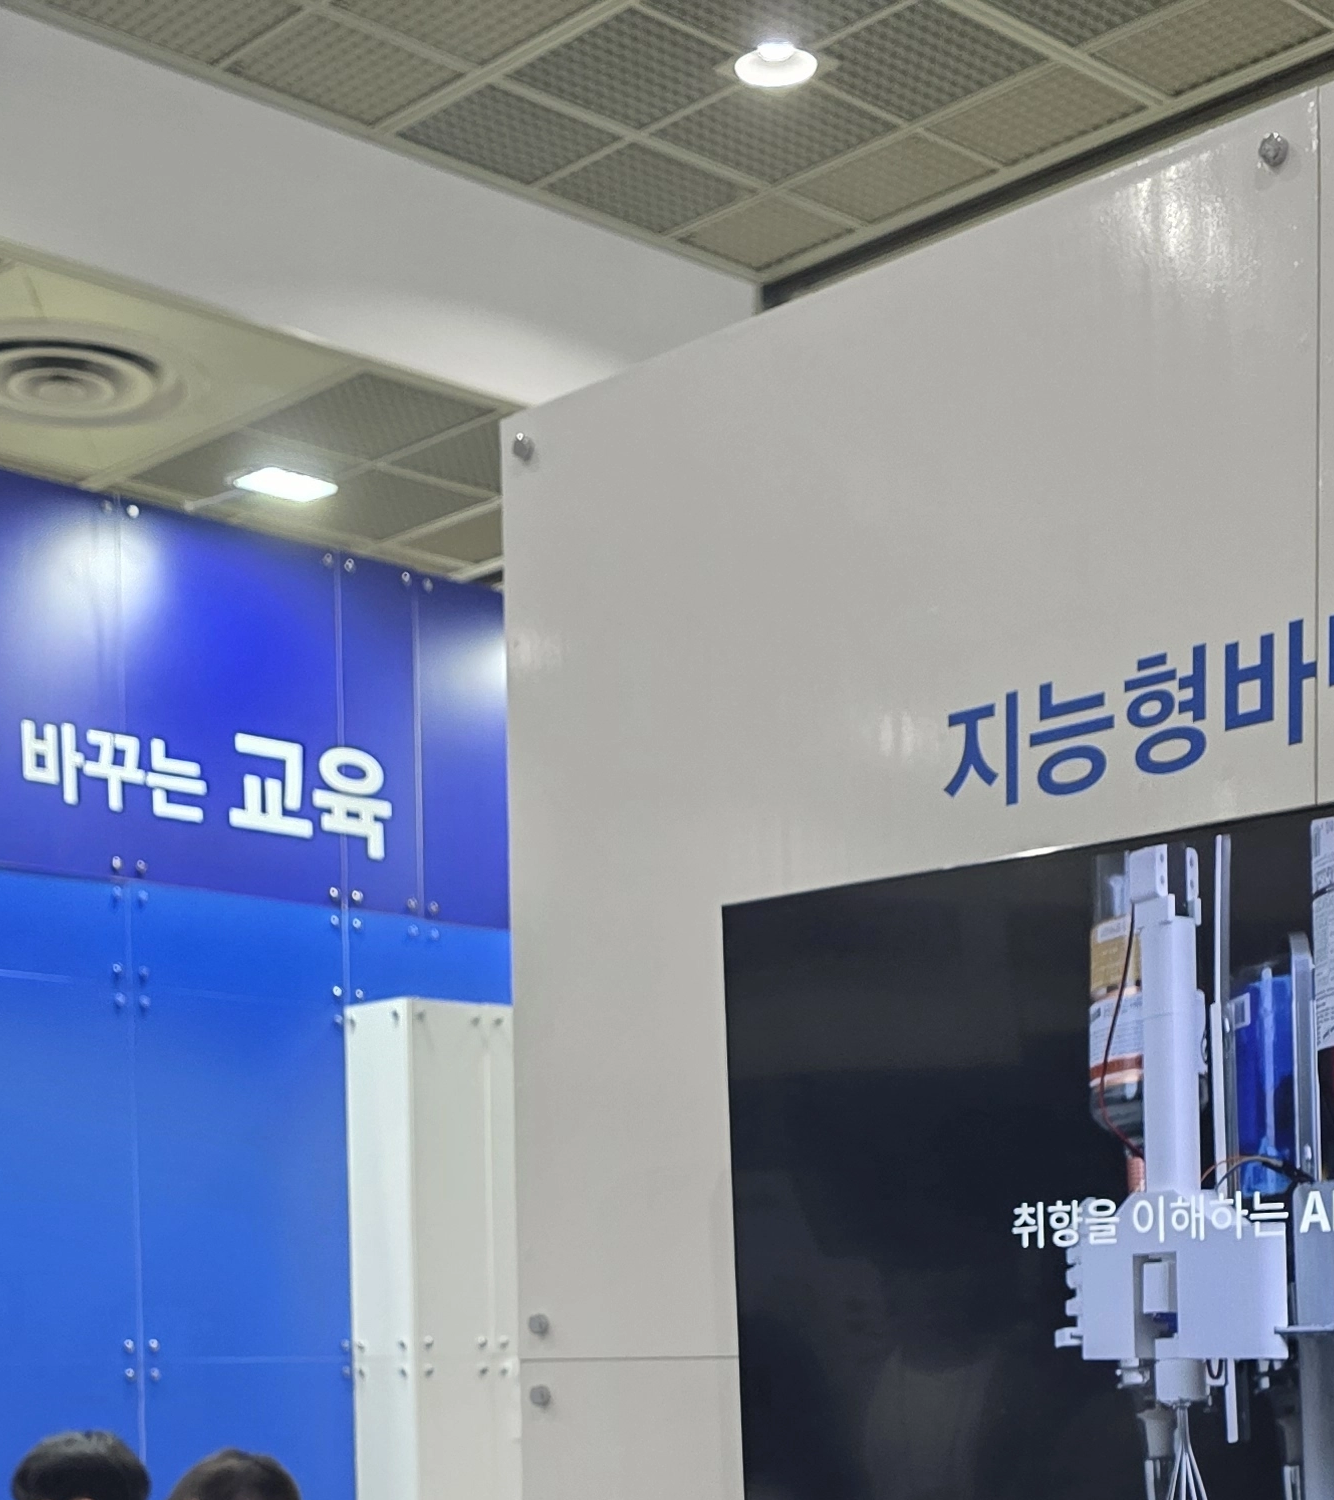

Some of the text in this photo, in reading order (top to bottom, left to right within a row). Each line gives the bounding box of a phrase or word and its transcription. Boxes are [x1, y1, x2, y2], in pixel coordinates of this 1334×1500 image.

[20, 719, 207, 824] 바꾸는
[228, 732, 393, 860] 교육
[1011, 1198, 1120, 1250] 취향을
[1133, 1193, 1290, 1243] 이해하는
